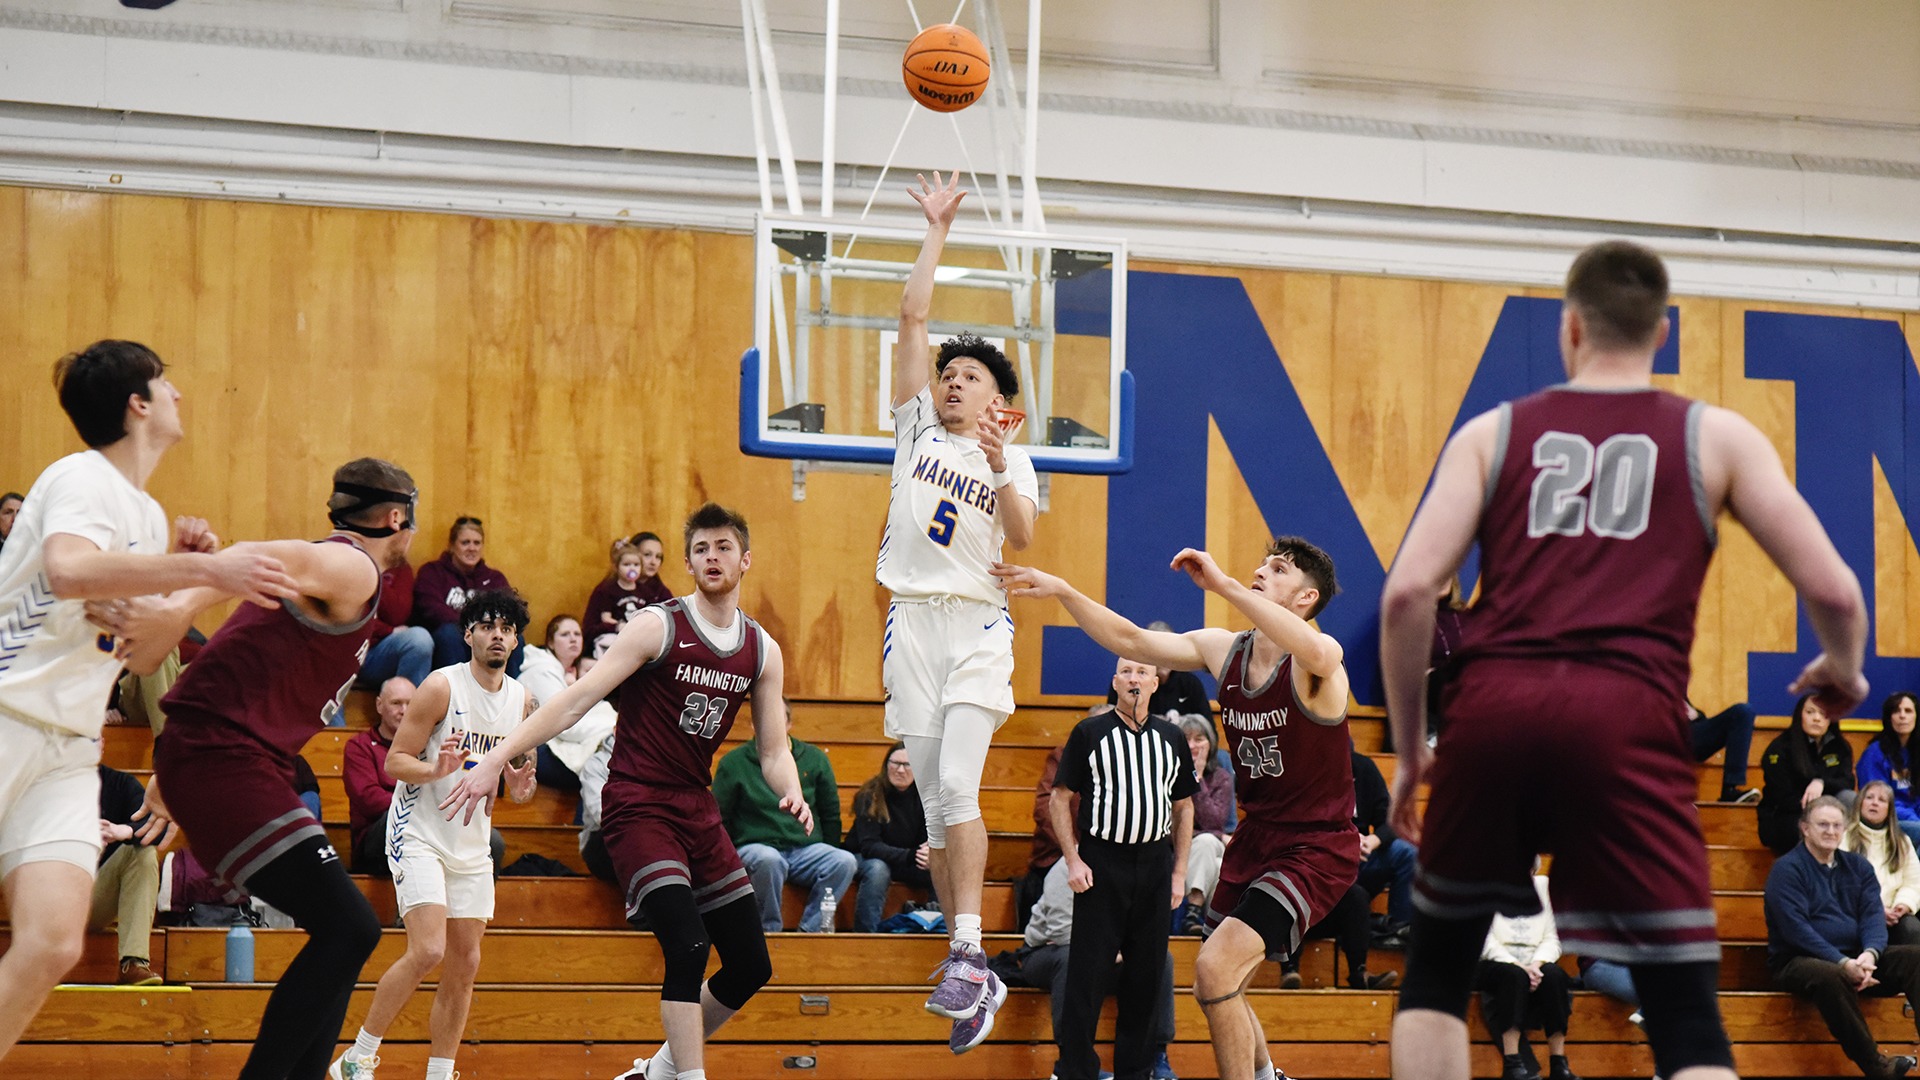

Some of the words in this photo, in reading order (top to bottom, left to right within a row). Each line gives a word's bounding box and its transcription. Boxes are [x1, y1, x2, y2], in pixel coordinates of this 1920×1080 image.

[918, 84, 975, 105] Wilson
[1528, 431, 1659, 540] 20
[927, 497, 959, 549] 5
[675, 663, 752, 693] FARMINGTON
[679, 692, 728, 739] 22
[1237, 735, 1285, 779] 45
